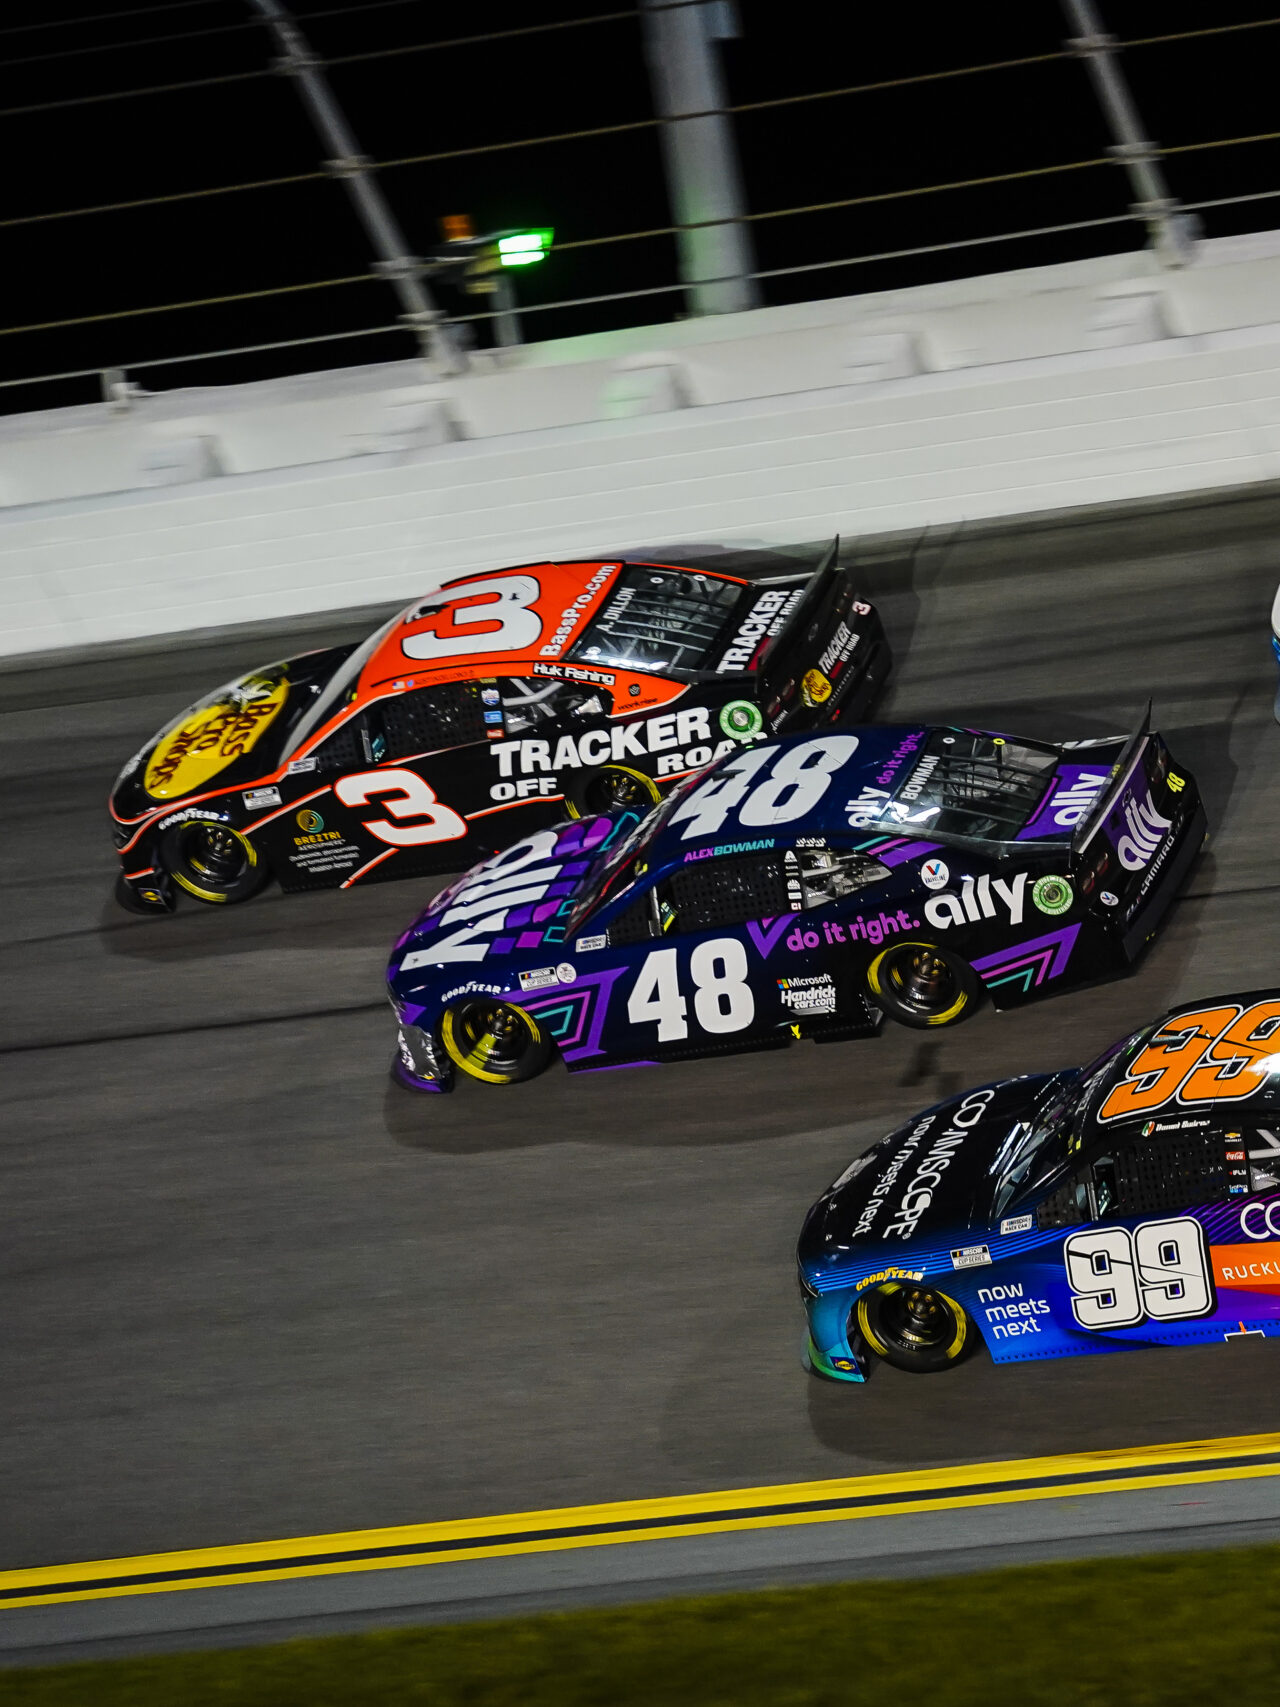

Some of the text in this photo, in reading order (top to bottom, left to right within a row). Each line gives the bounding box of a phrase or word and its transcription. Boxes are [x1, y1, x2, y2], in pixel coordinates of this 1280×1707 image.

[401, 572, 543, 661] 3
[539, 565, 617, 656] BassPro.com
[603, 587, 637, 621] DILLON
[780, 589, 805, 616] ROAD
[852, 600, 871, 616] 3
[716, 590, 791, 674] TRACKER
[818, 621, 852, 674] TRACKER
[533, 663, 616, 686] Huk Fishing
[220, 702, 279, 757] Bass
[490, 706, 712, 778] TRACKER
[489, 777, 558, 802] OFF
[667, 736, 860, 840] 48
[876, 770, 896, 784] do
[900, 755, 940, 800] BOWMAN
[1166, 771, 1186, 793] 48
[334, 767, 468, 847] 3
[845, 786, 891, 827] ally
[1050, 773, 1108, 826] ally
[293, 831, 341, 846] BREZTRI
[1118, 789, 1173, 871] ally
[1141, 834, 1175, 896] CAMARO
[925, 872, 1028, 930] ally
[786, 910, 921, 951] do it right.
[441, 981, 502, 1003] GOODYEAR
[627, 938, 755, 1042] 48
[781, 985, 836, 1007] Hendrick
[787, 973, 833, 988] Microsoft
[852, 1115, 936, 1237] now meets next
[856, 1267, 924, 1291] GOODYEAR
[958, 1254, 985, 1265] CUP SERIES
[1063, 1216, 1212, 1330] 99
[977, 1283, 1024, 1303] now
[985, 1298, 1051, 1323] meets
[993, 1318, 1042, 1339] next
